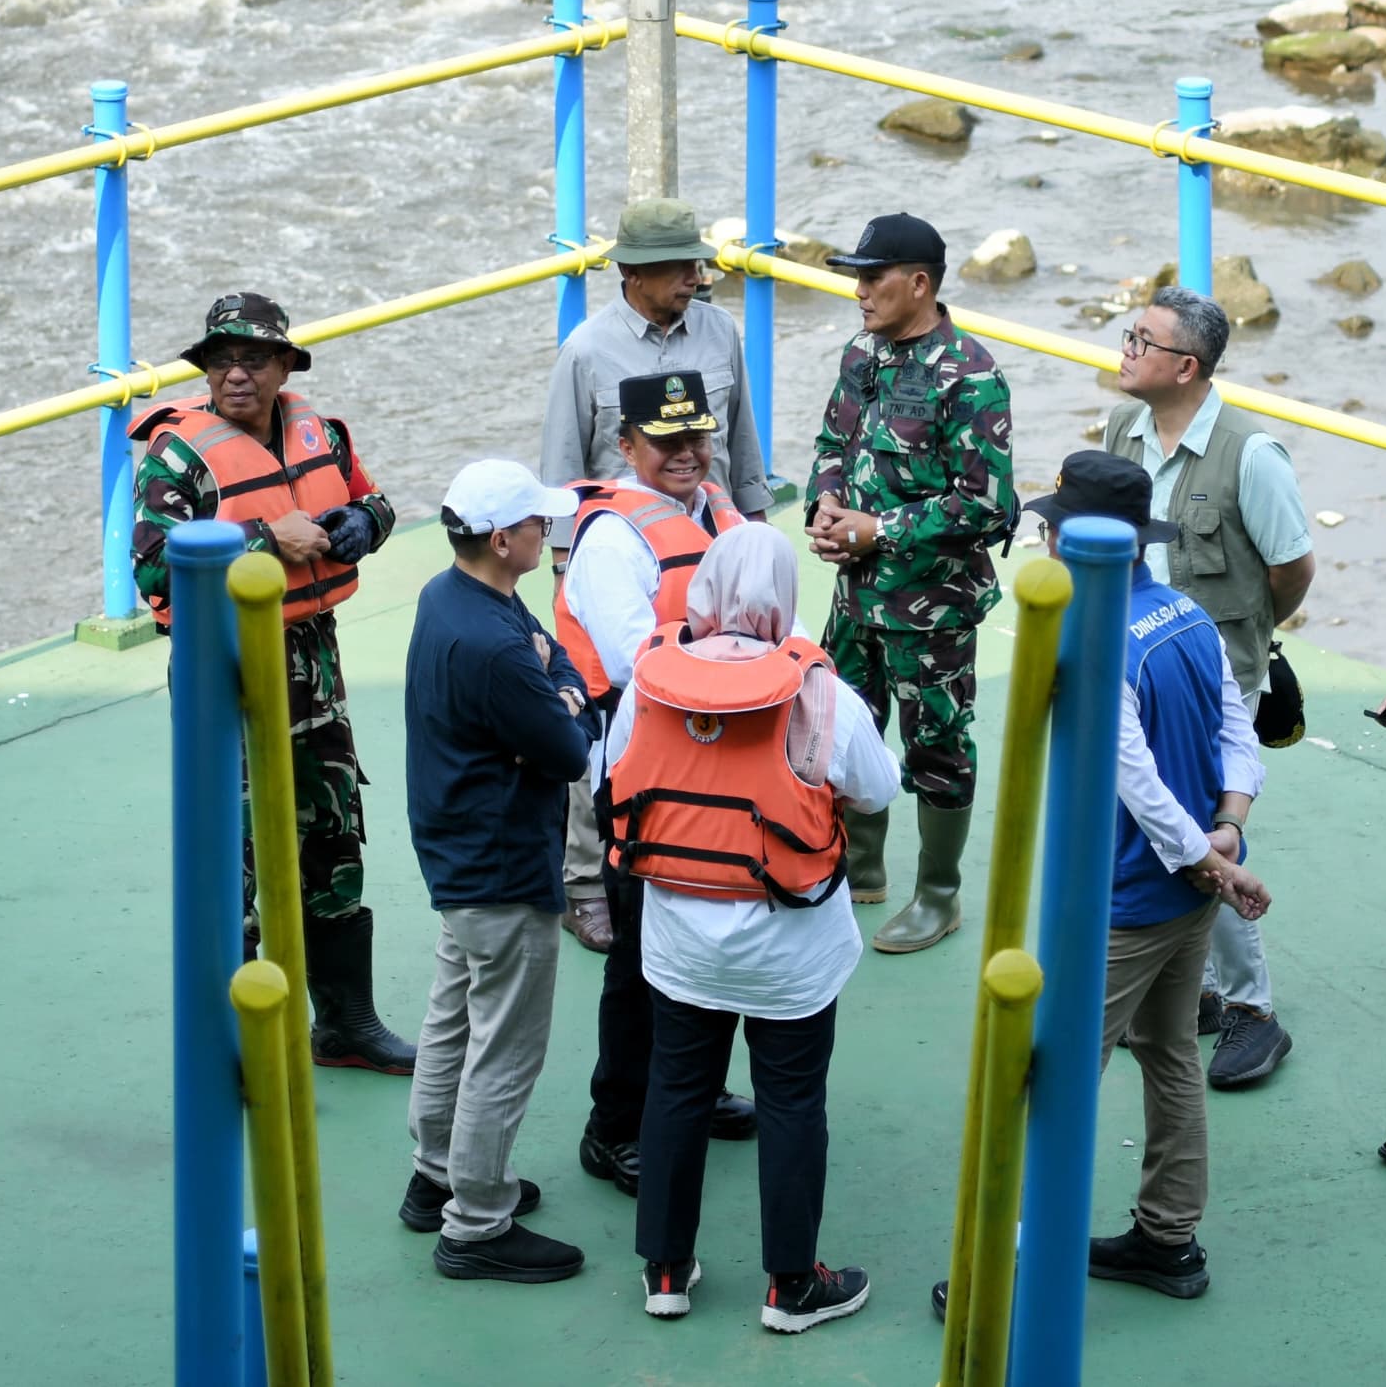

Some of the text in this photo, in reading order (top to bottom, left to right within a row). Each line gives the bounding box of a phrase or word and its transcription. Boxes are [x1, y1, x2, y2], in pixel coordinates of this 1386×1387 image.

[889, 402, 926, 417] TNI AD
[1129, 611, 1164, 640] DINAS
[699, 713, 710, 732] 3
